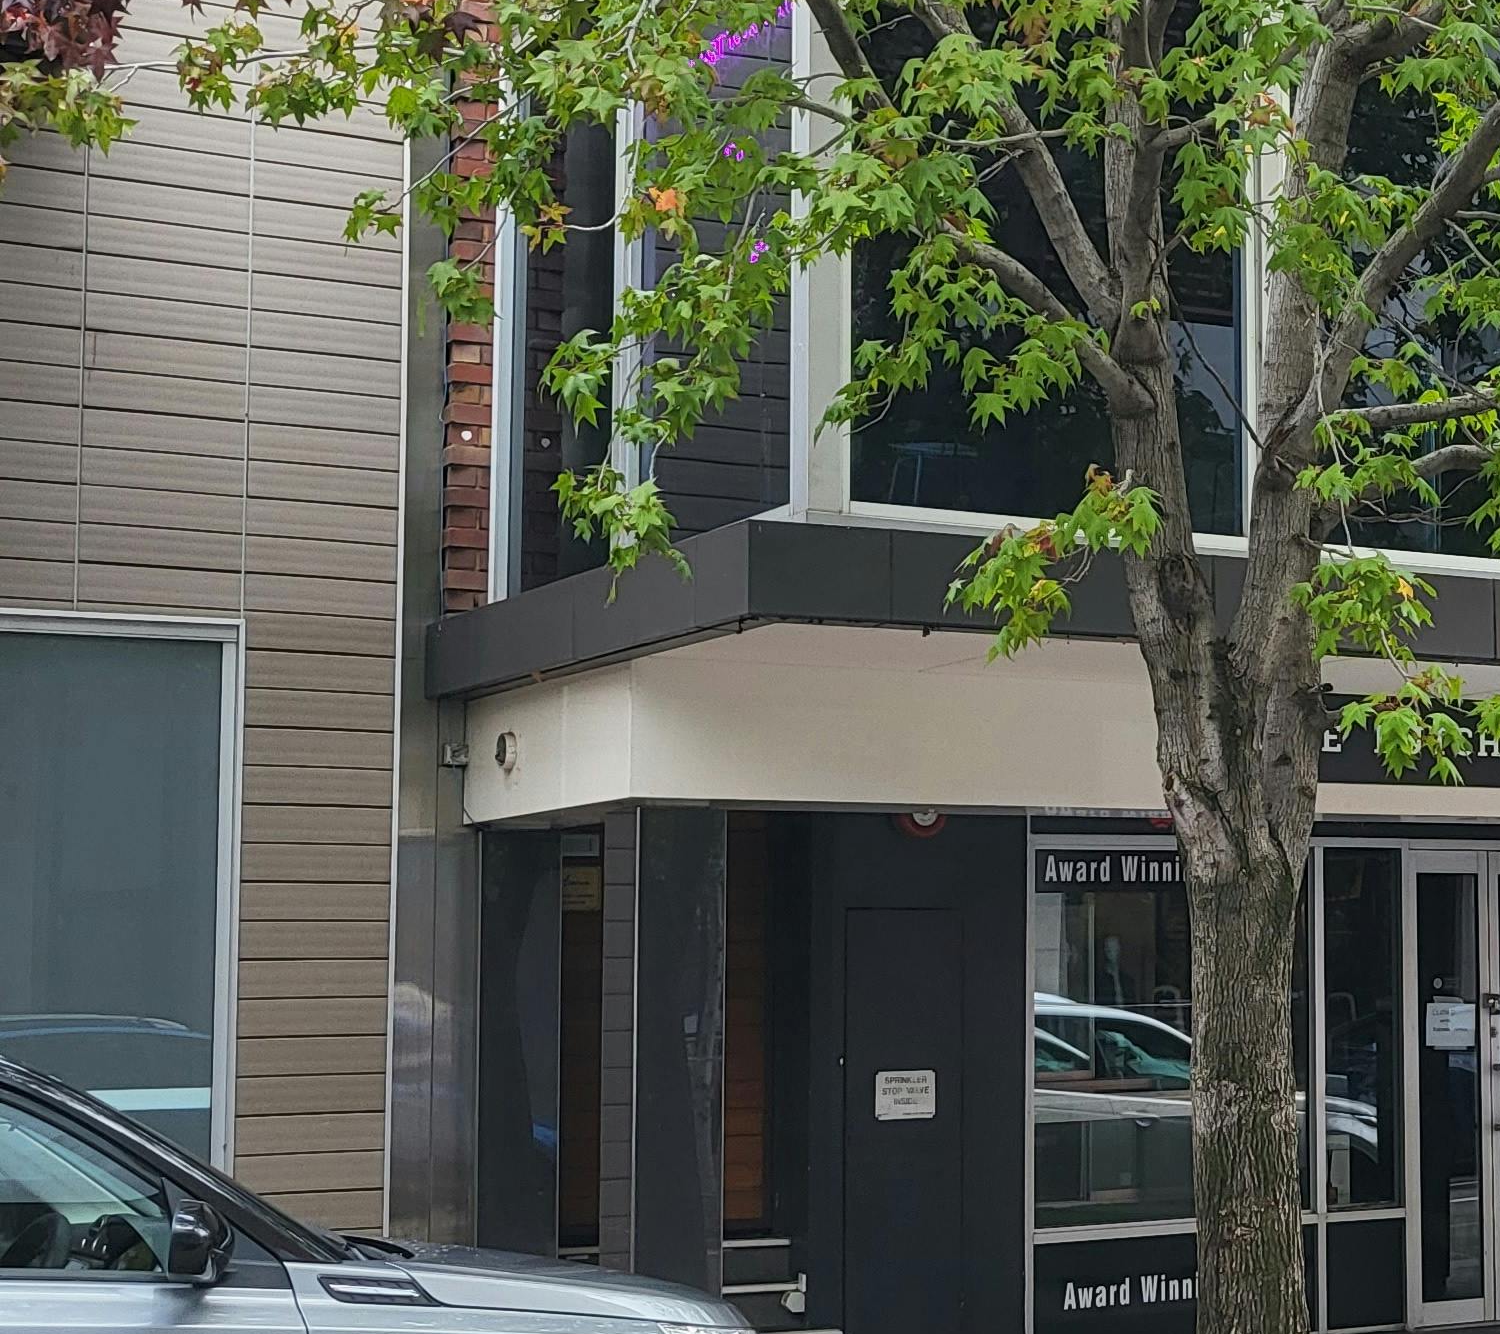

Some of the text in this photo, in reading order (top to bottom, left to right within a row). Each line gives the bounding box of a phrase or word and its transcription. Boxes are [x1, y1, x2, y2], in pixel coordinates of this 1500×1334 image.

[1044, 854, 1184, 882] Award Winni
[881, 1087, 902, 1096] STOP
[1063, 1270, 1199, 1311] Award Winni
